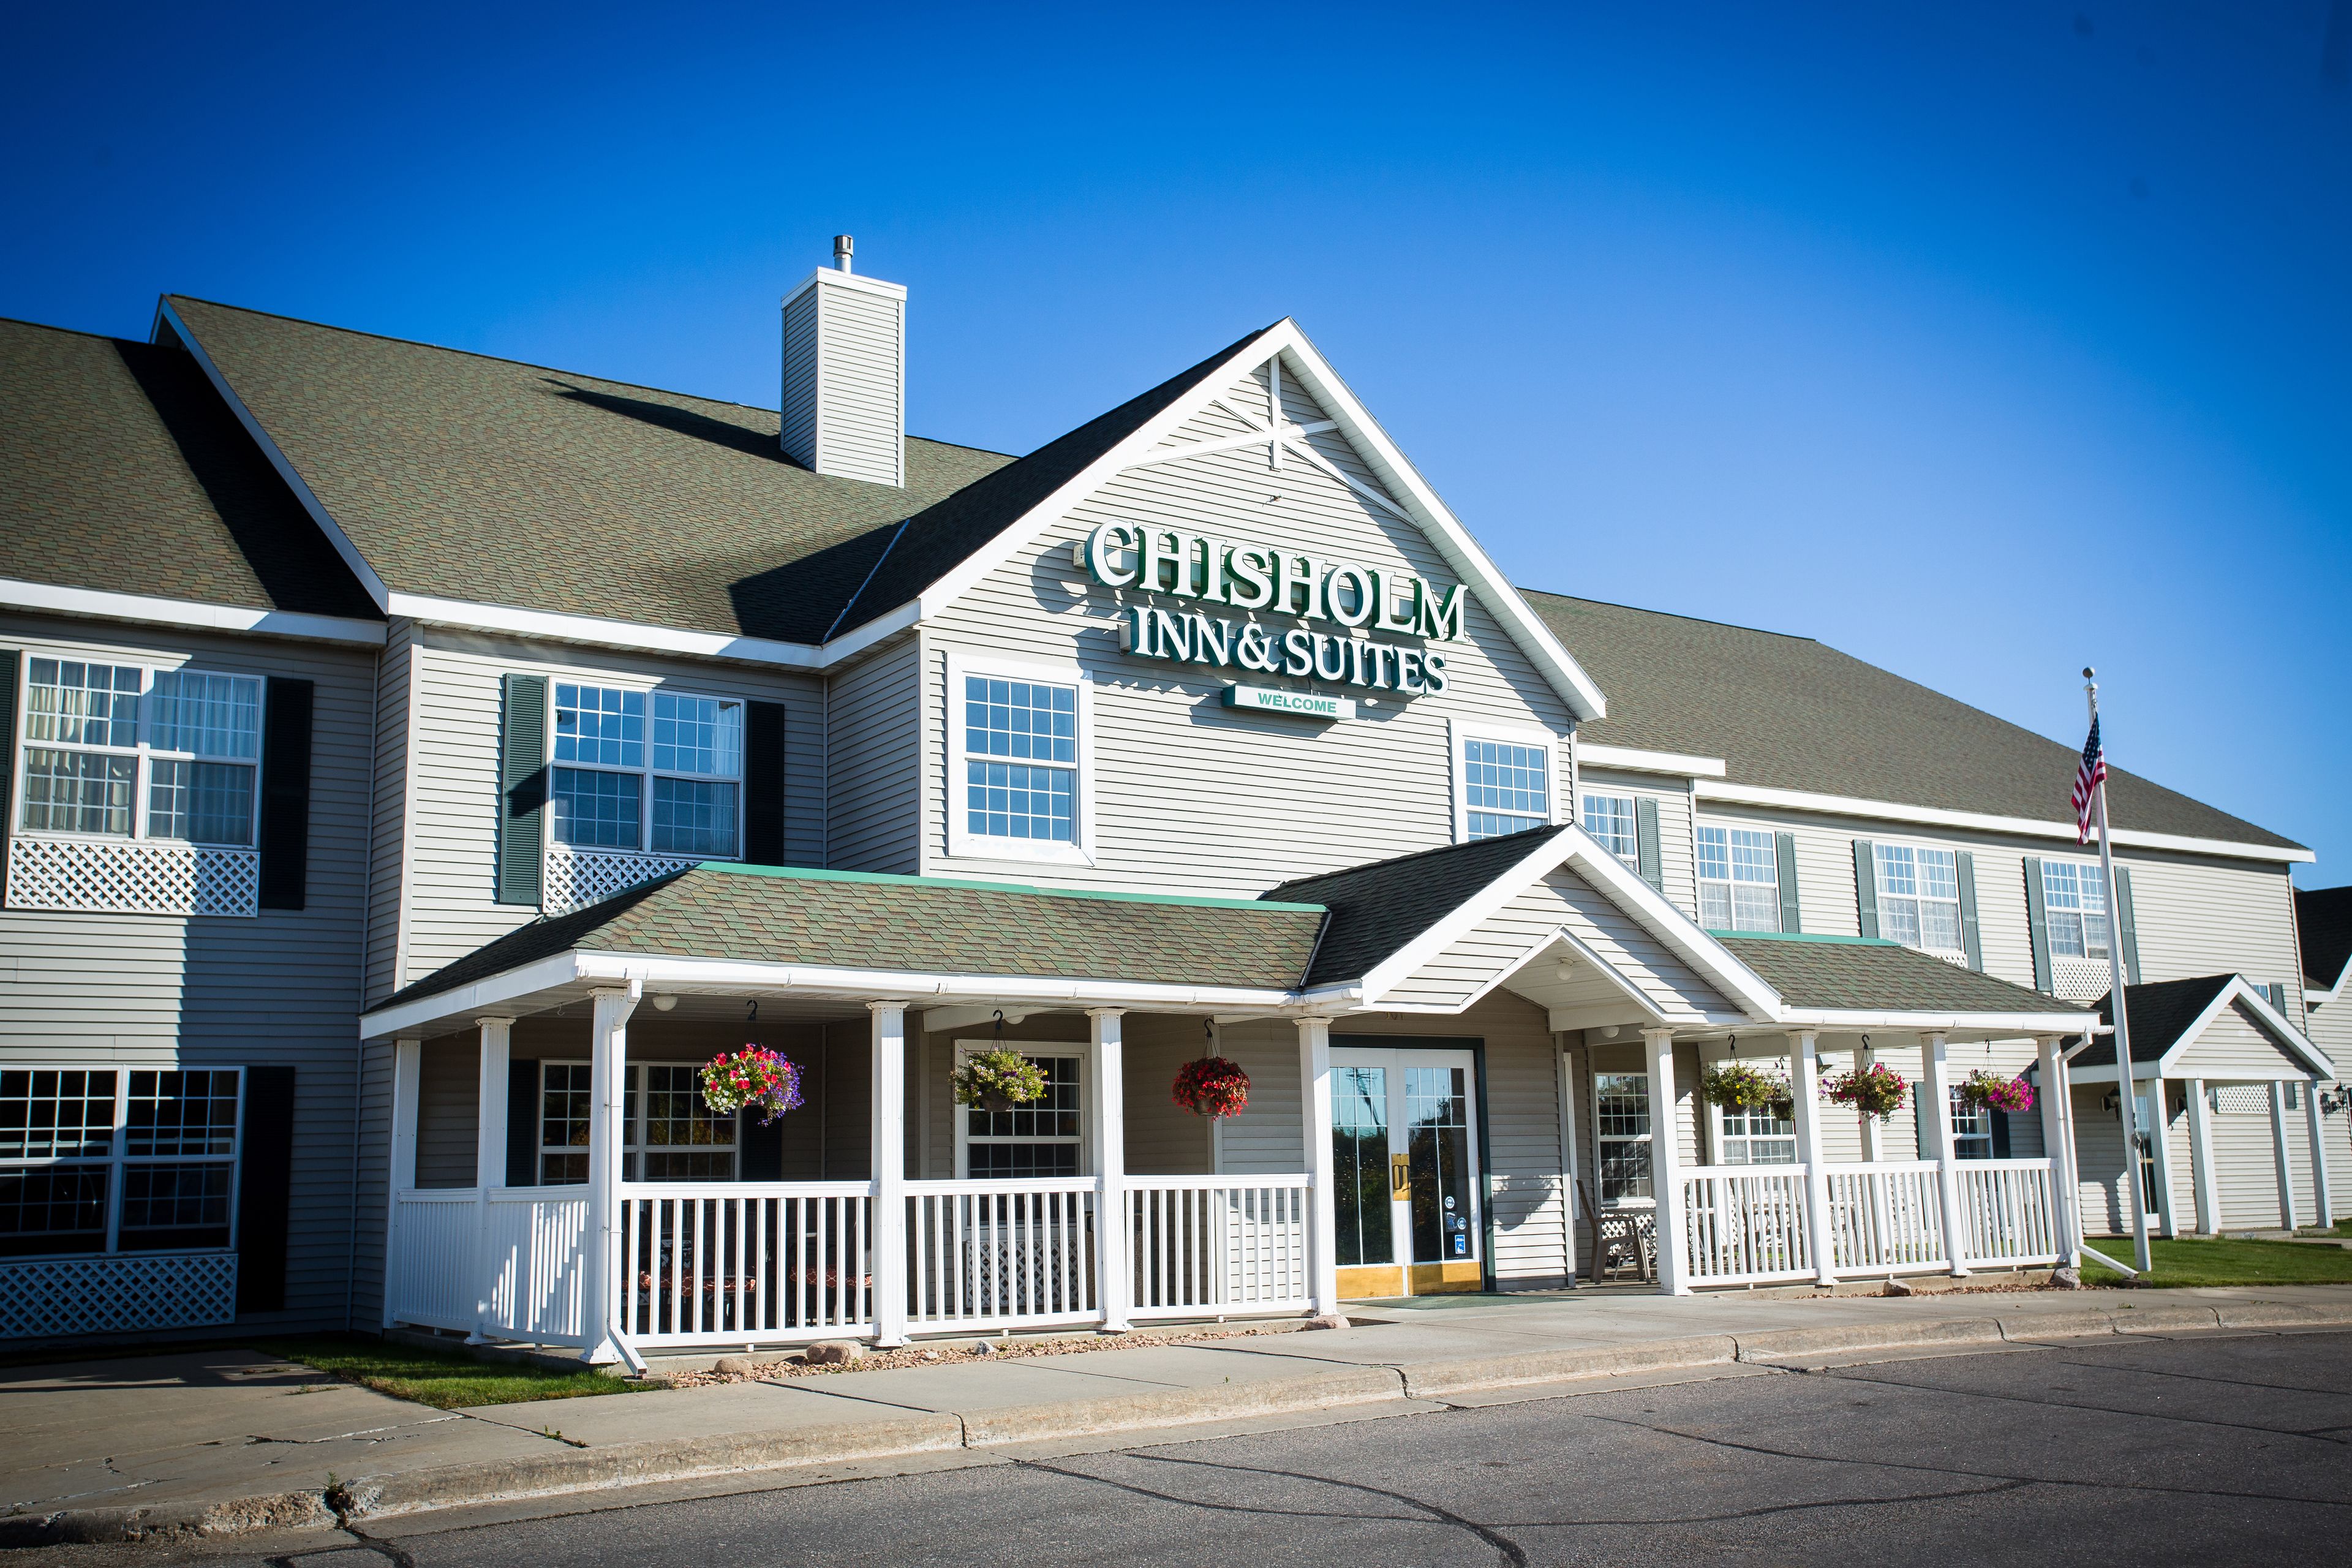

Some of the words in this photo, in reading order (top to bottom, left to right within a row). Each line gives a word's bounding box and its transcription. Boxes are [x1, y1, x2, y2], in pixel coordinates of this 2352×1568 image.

[1090, 519, 1469, 643] CHISHOLM
[1130, 605, 1232, 666] INN
[1283, 628, 1450, 696] SUITES
[1257, 692, 1337, 714] WELCOME
